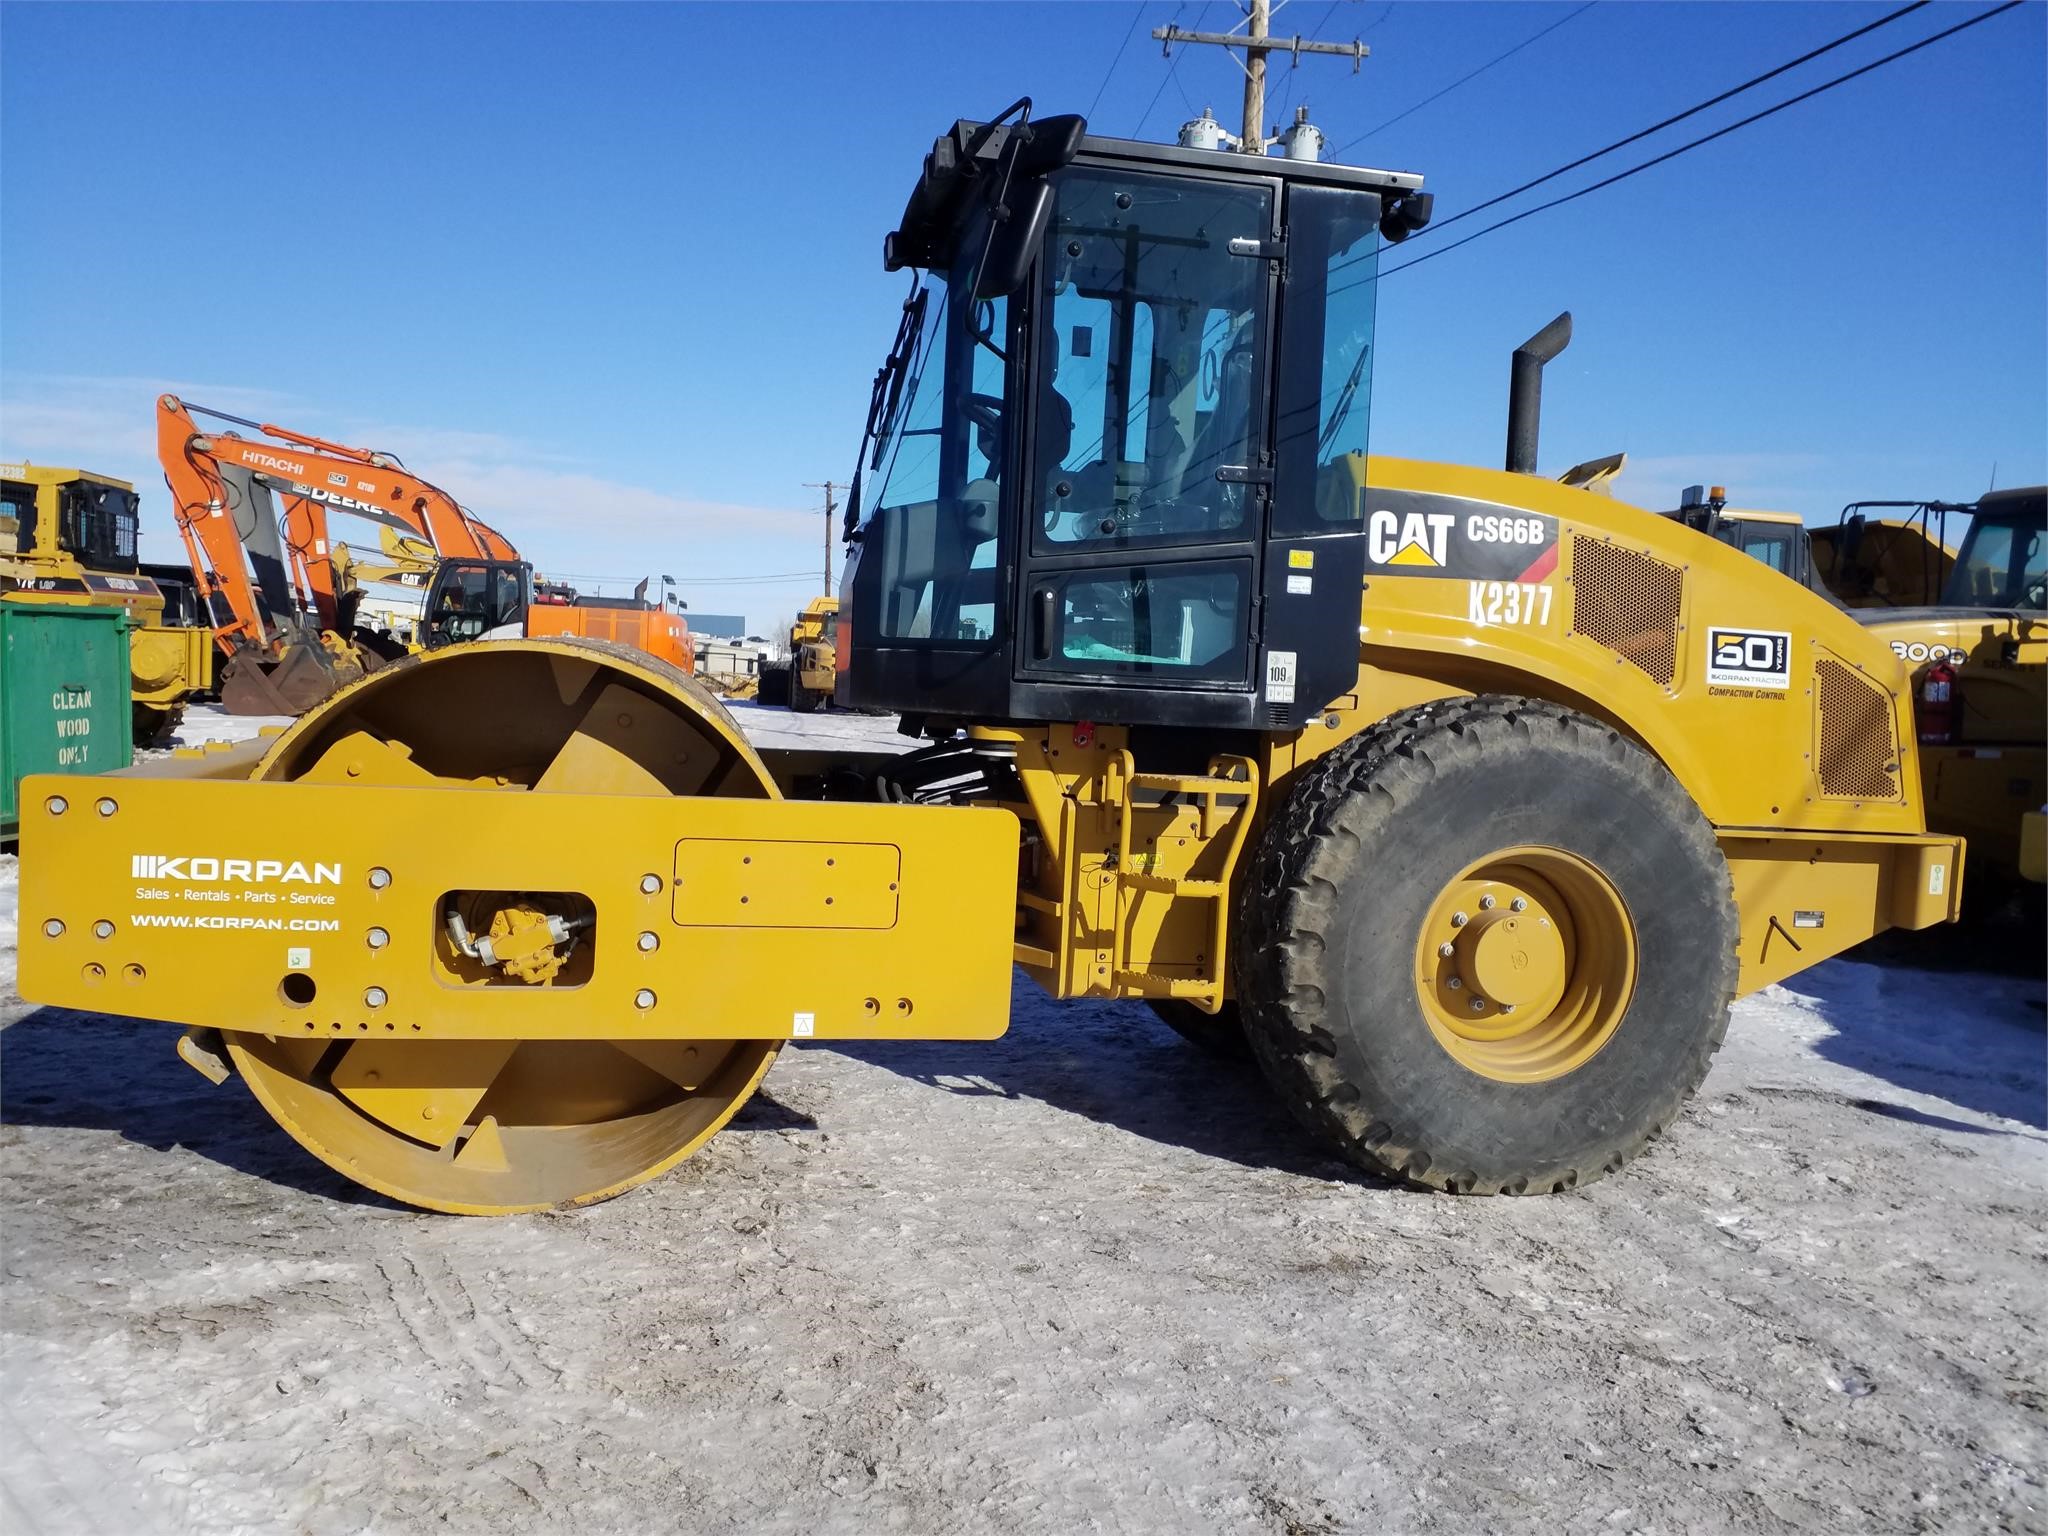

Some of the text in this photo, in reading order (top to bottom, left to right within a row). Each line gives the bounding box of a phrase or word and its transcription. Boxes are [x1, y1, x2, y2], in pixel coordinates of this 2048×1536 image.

[242, 450, 304, 475] HITACHI
[311, 488, 383, 515] DEERE
[1368, 510, 1545, 567] CAT CS66B
[401, 573, 421, 586] CAT
[1469, 581, 1553, 626] K2377
[1715, 634, 1774, 669] 50
[1776, 637, 1784, 671] YEARS
[1269, 666, 1287, 682] 109
[1711, 673, 1786, 685] KORPAN TRACTOR
[52, 690, 92, 710] CLEAN
[1708, 686, 1786, 701] COMPACTION CONTROL
[56, 718, 90, 738] WOOD
[59, 745, 89, 766] ONLY
[131, 855, 342, 885] KORPAN
[136, 888, 335, 905] Sales Rentals Parts Service
[130, 914, 340, 931] WWW.KORPAN.COM
